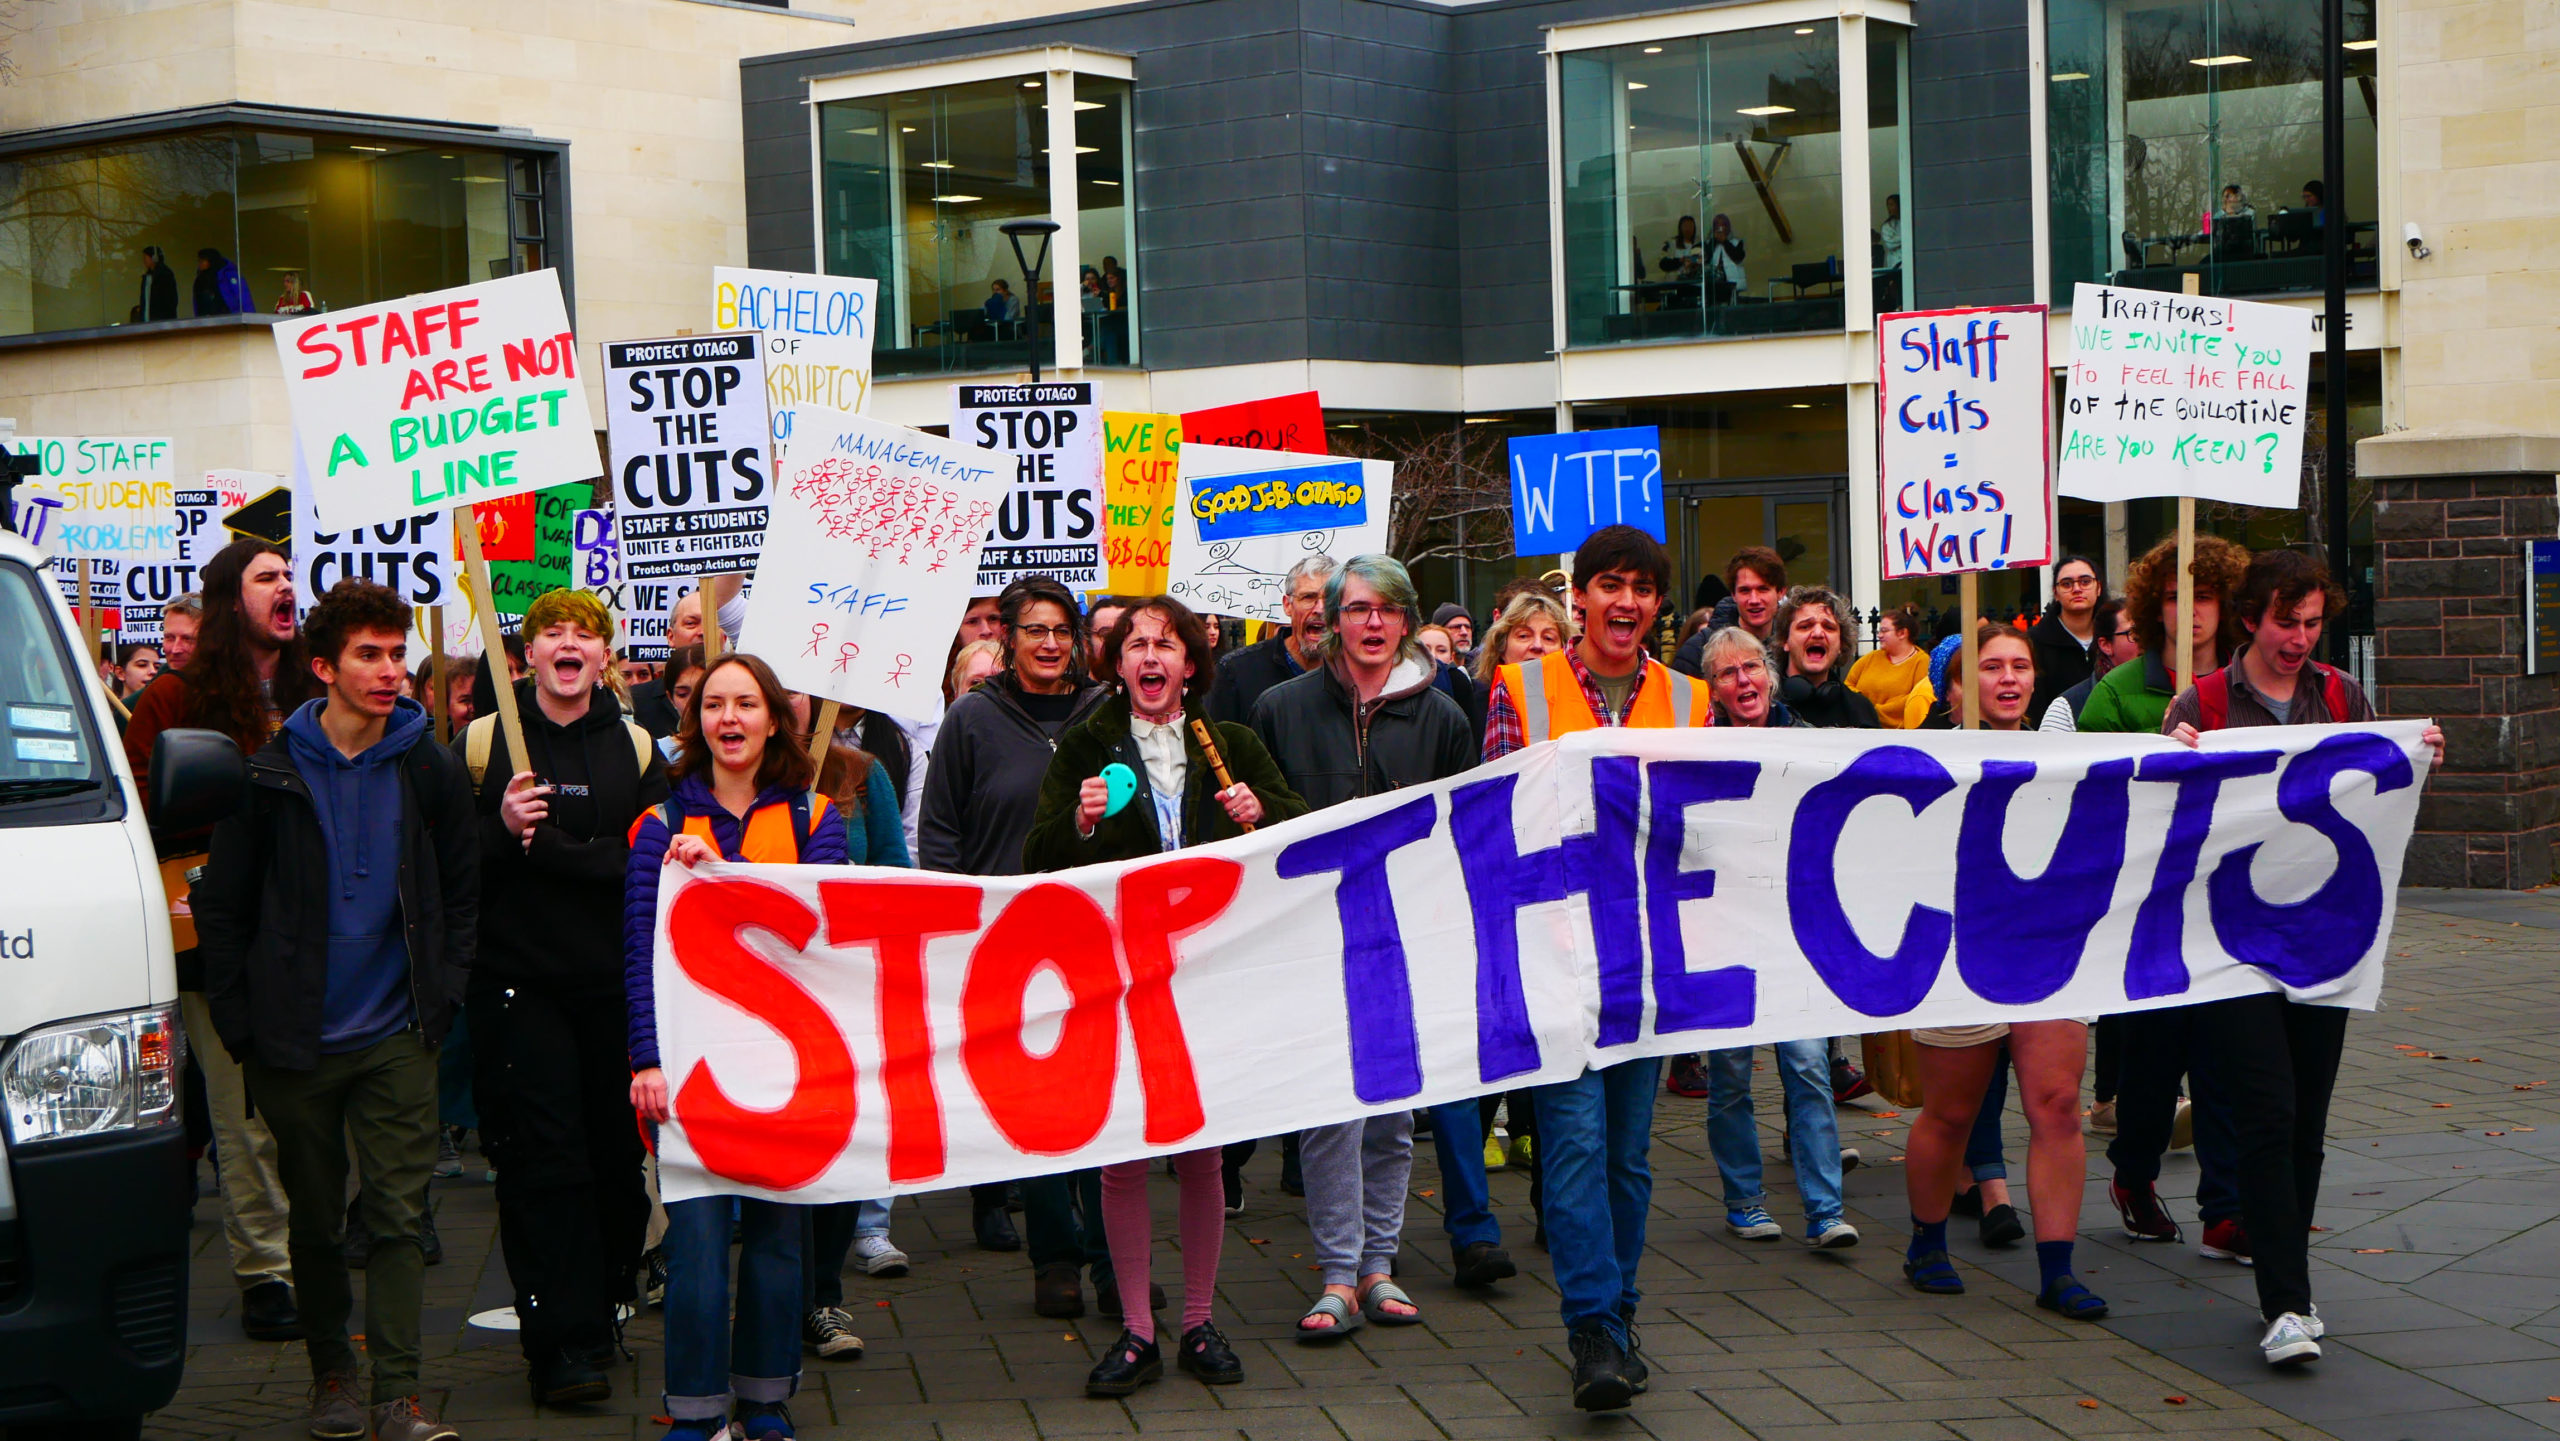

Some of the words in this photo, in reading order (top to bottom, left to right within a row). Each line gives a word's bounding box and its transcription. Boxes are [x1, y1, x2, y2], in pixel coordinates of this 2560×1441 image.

[717, 282, 864, 339] BACHELOR
[296, 298, 480, 380] STAFF
[625, 345, 690, 362] PROTECT
[693, 340, 739, 357] OTAGO
[771, 338, 801, 355] OF
[2074, 324, 2113, 351] WE
[400, 353, 493, 411] ARE
[502, 331, 576, 382] NOT
[2121, 363, 2174, 386] FEEL
[2237, 369, 2296, 391] FALL
[629, 365, 741, 413] STOP
[767, 363, 869, 414] KRUPTCY
[974, 388, 1031, 403] PROTECT
[1035, 387, 1078, 401] OTAGO
[1899, 390, 1990, 435] Cuts
[2069, 396, 2100, 415] OF
[327, 433, 369, 478] A
[390, 388, 569, 464] BUDGET
[652, 412, 719, 447] THE
[976, 410, 1078, 450] STOP
[1103, 421, 1154, 453] WE
[76, 439, 167, 475] STAFF
[831, 432, 995, 483] MANAGEMENT
[2064, 429, 2107, 462] ARE
[2116, 434, 2155, 465] YOU
[2172, 432, 2279, 475] KEEN?
[206, 474, 243, 490] Enrol
[412, 450, 518, 507] LINE
[623, 447, 765, 509] CUTS
[1015, 453, 1055, 483] HE
[58, 480, 174, 512] STUDENTS
[176, 493, 207, 503] OTAGO
[221, 490, 248, 508] OW
[534, 492, 577, 520] TOP
[1191, 483, 1252, 525] GOOD
[1295, 480, 1364, 509] OTAGO
[1515, 447, 1661, 535] WTF?
[1897, 479, 2006, 521] Class
[175, 508, 208, 537] OP
[625, 516, 671, 536] STAFF
[674, 515, 686, 532] &
[690, 509, 768, 531] STUDENTS
[985, 488, 1096, 542] UTS
[1106, 503, 1153, 527] THEY
[626, 539, 671, 557] UNITE
[674, 538, 686, 553] &
[1011, 549, 1023, 565] &
[1026, 547, 1097, 564] STUDENTS
[1900, 513, 2013, 572] War!
[52, 557, 120, 576] FIGTBA
[538, 554, 572, 576] OUR
[633, 563, 671, 577] Protect
[672, 561, 703, 575] Otago
[705, 558, 737, 571] Action
[739, 556, 758, 568] Gro
[976, 572, 1007, 586] NITE
[126, 565, 208, 602] CUT
[633, 585, 669, 611] WE
[125, 607, 157, 619] STAFF
[808, 582, 910, 620] STAFF
[126, 622, 156, 633] UNITE
[630, 618, 672, 637] FIGH
[638, 647, 676, 659] PROTEC
[0, 927, 34, 959] td
[665, 856, 1245, 1191] STOP
[1276, 754, 1762, 1105] THE
[1786, 731, 2414, 1018] CUTS
